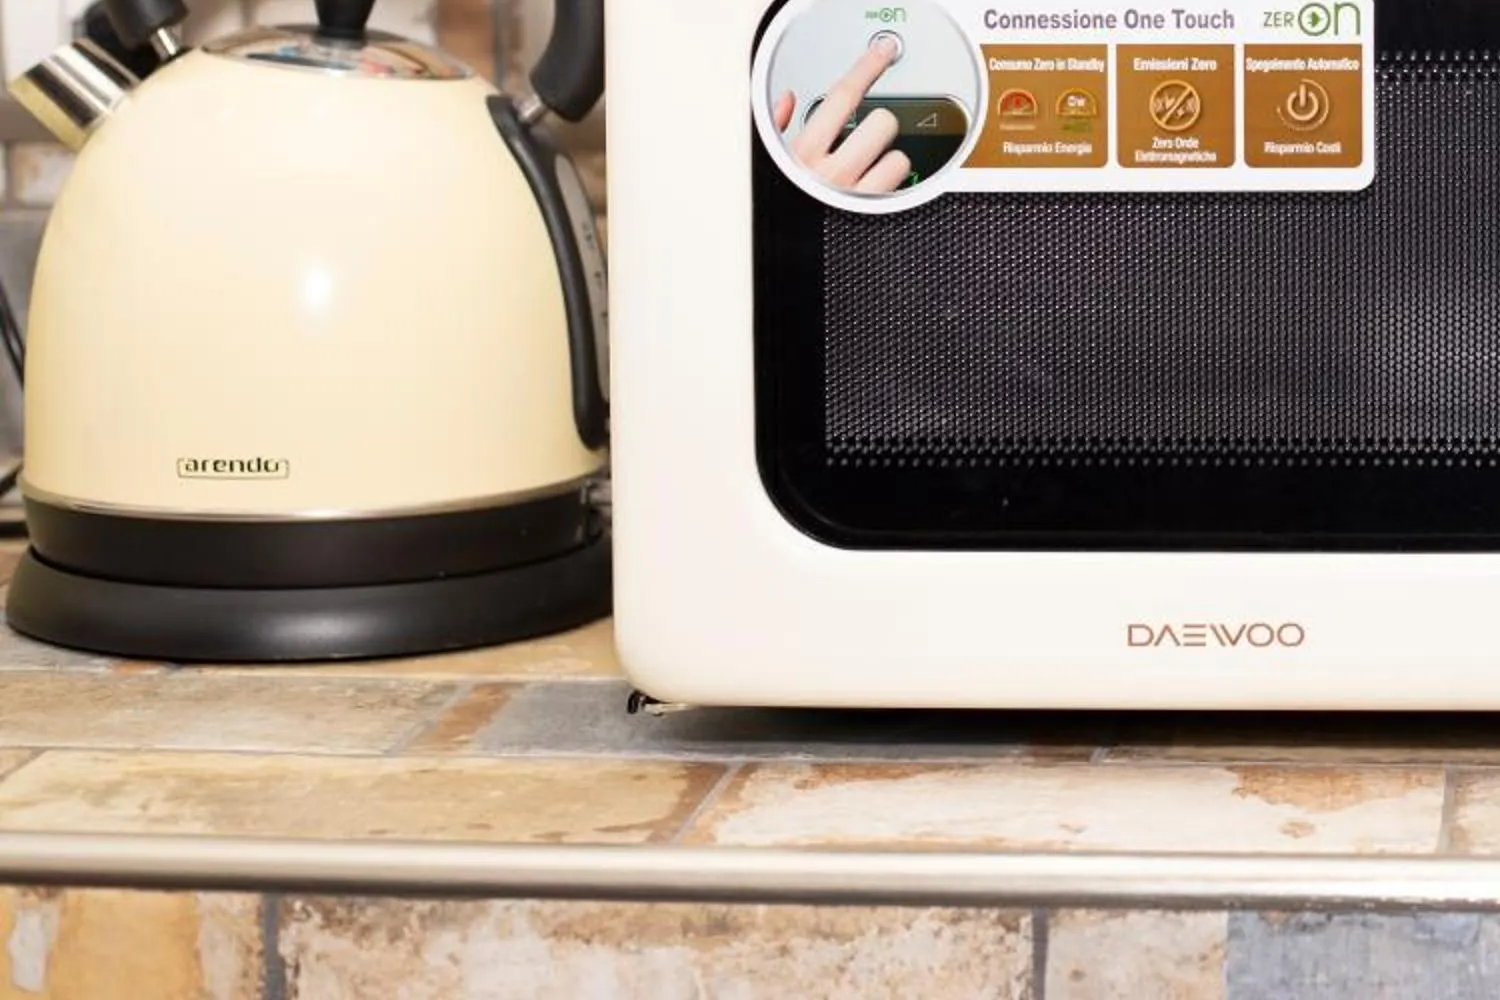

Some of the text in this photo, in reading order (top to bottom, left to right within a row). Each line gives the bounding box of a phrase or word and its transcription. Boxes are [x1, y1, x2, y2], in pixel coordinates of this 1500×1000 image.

[983, 7, 1118, 31] Connessione
[1122, 7, 1166, 31] One
[1171, 7, 1236, 31] Touch
[1034, 57, 1055, 71] Zero
[1133, 57, 1218, 71] Emissioni Zero
[1263, 141, 1315, 156] Risparmio
[184, 456, 280, 474] arendo
[1126, 622, 1306, 648] DAEWOO
